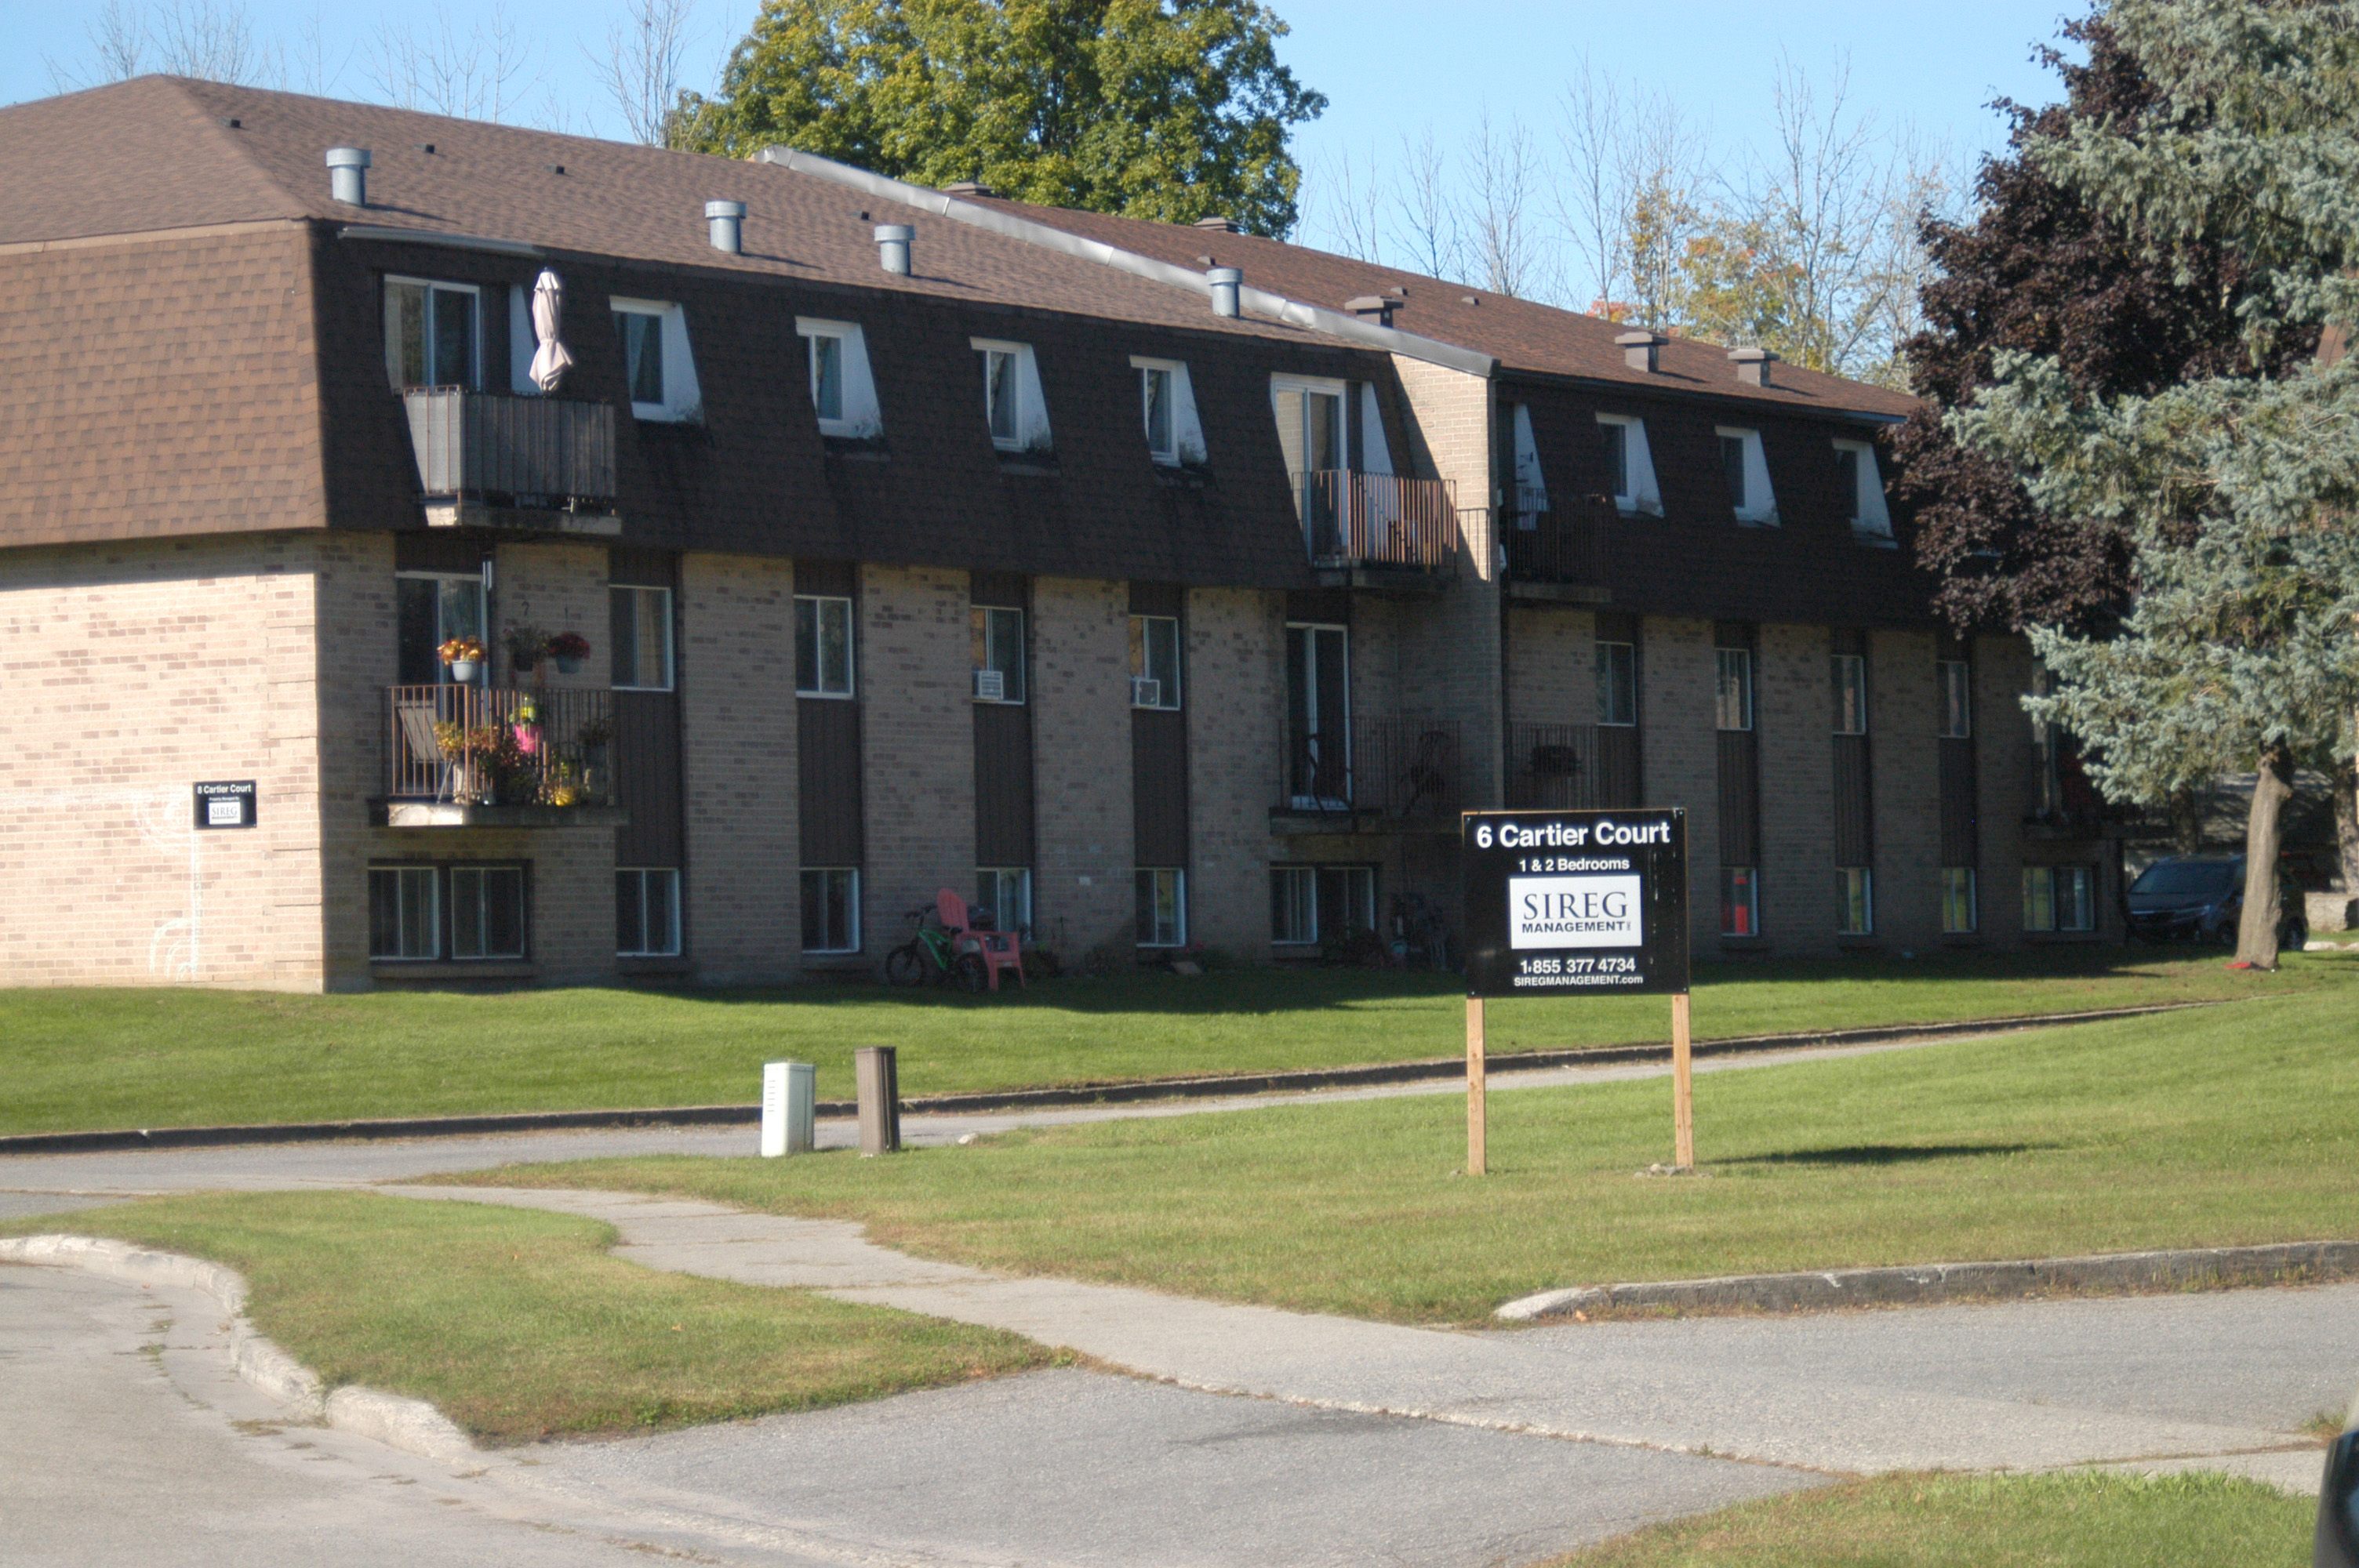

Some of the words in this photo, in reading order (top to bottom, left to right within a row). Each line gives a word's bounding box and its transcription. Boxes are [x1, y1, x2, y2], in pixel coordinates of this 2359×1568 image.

[198, 786, 202, 794] 8
[204, 785, 229, 794] Cartier
[230, 784, 251, 793] Court
[212, 807, 237, 815] SIREG
[1477, 826, 1492, 848] 6
[1499, 823, 1589, 848] Cartier
[1595, 821, 1670, 845] Court
[1519, 859, 1526, 872] 1
[1531, 858, 1543, 872] &
[1545, 858, 1554, 872] 2
[1558, 858, 1630, 871] Bedrooms
[1523, 891, 1628, 920] SIREG
[1521, 920, 1626, 933] MANAGEMENT
[1566, 958, 1595, 973] 377
[1598, 956, 1636, 972] 4734
[1514, 975, 1644, 987] SIREGMANAGEMENT.com
